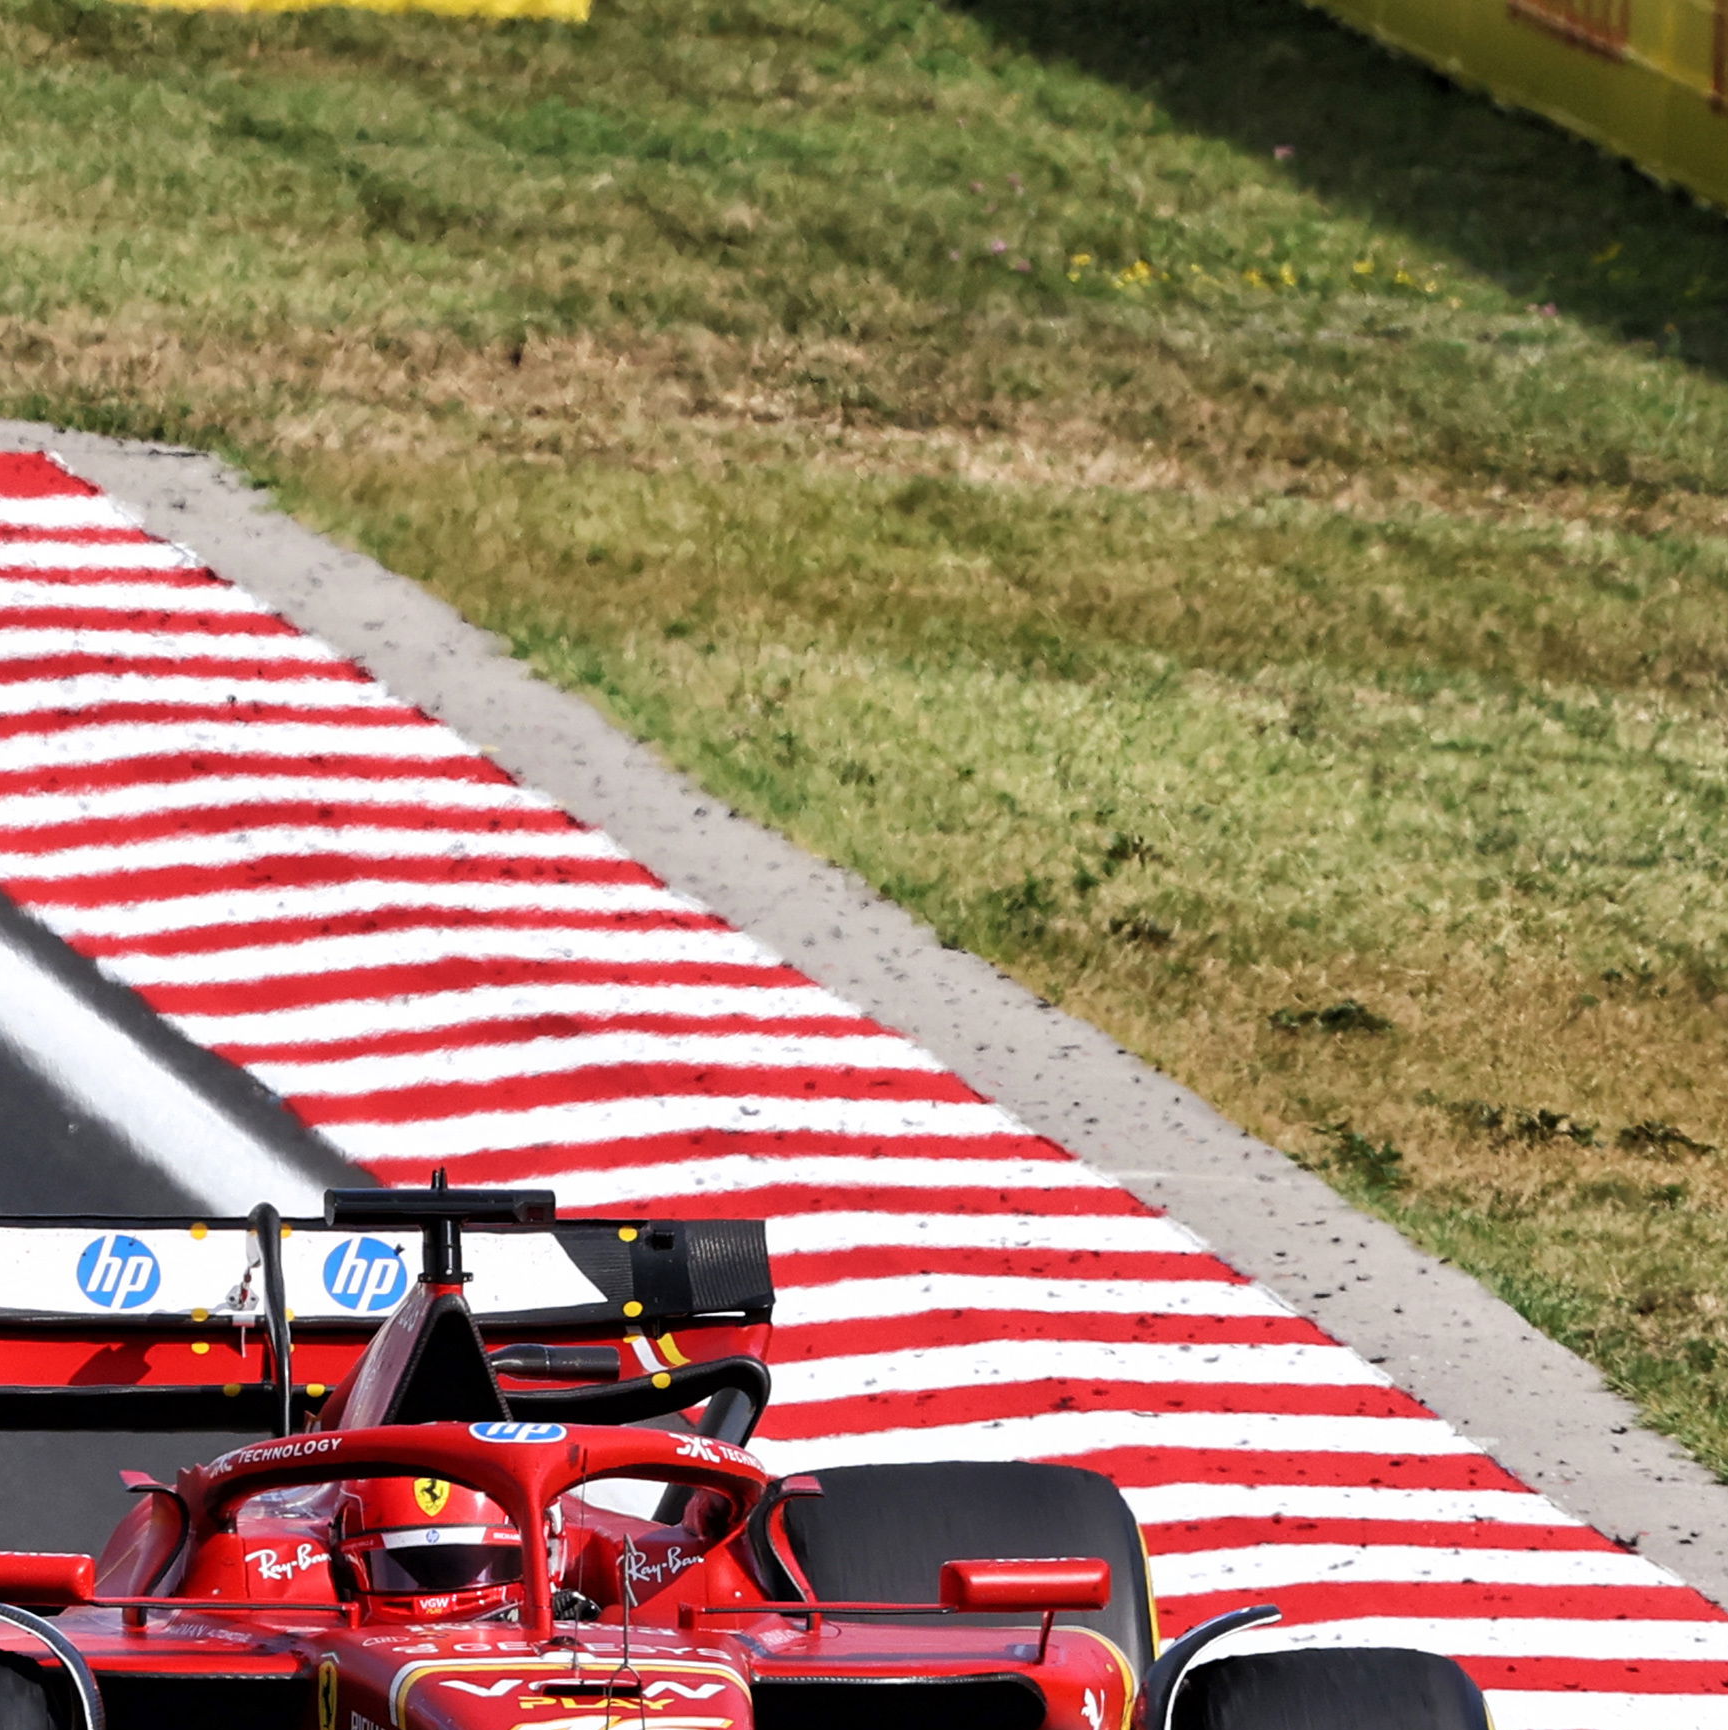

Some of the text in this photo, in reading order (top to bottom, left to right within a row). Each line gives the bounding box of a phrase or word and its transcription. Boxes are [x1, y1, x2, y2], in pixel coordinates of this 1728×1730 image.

[86, 1234, 155, 1310] hp
[332, 1236, 400, 1312] hp
[238, 1438, 342, 1464] TECHNOLOGY
[245, 1543, 332, 1580] Ray-Ban
[616, 1546, 704, 1582] Ray-Ban
[419, 1597, 450, 1610] VGW
[518, 1696, 675, 1710] PLAY
